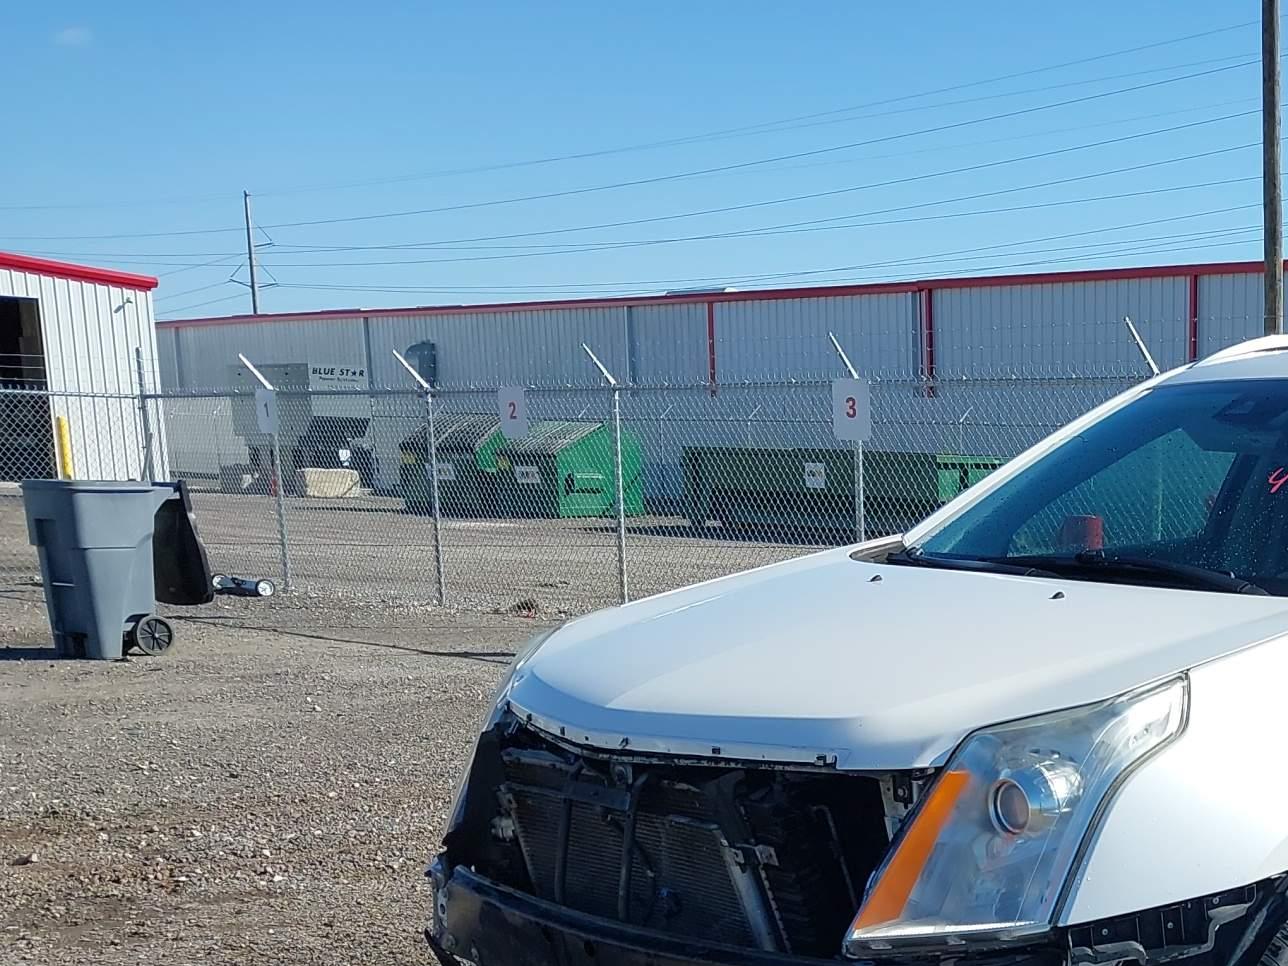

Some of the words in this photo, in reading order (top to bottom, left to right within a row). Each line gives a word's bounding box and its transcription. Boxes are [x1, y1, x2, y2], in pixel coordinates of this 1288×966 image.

[311, 367, 335, 376] BLUE
[263, 401, 270, 418] 1
[508, 401, 518, 420] 2
[845, 396, 857, 419] 3
